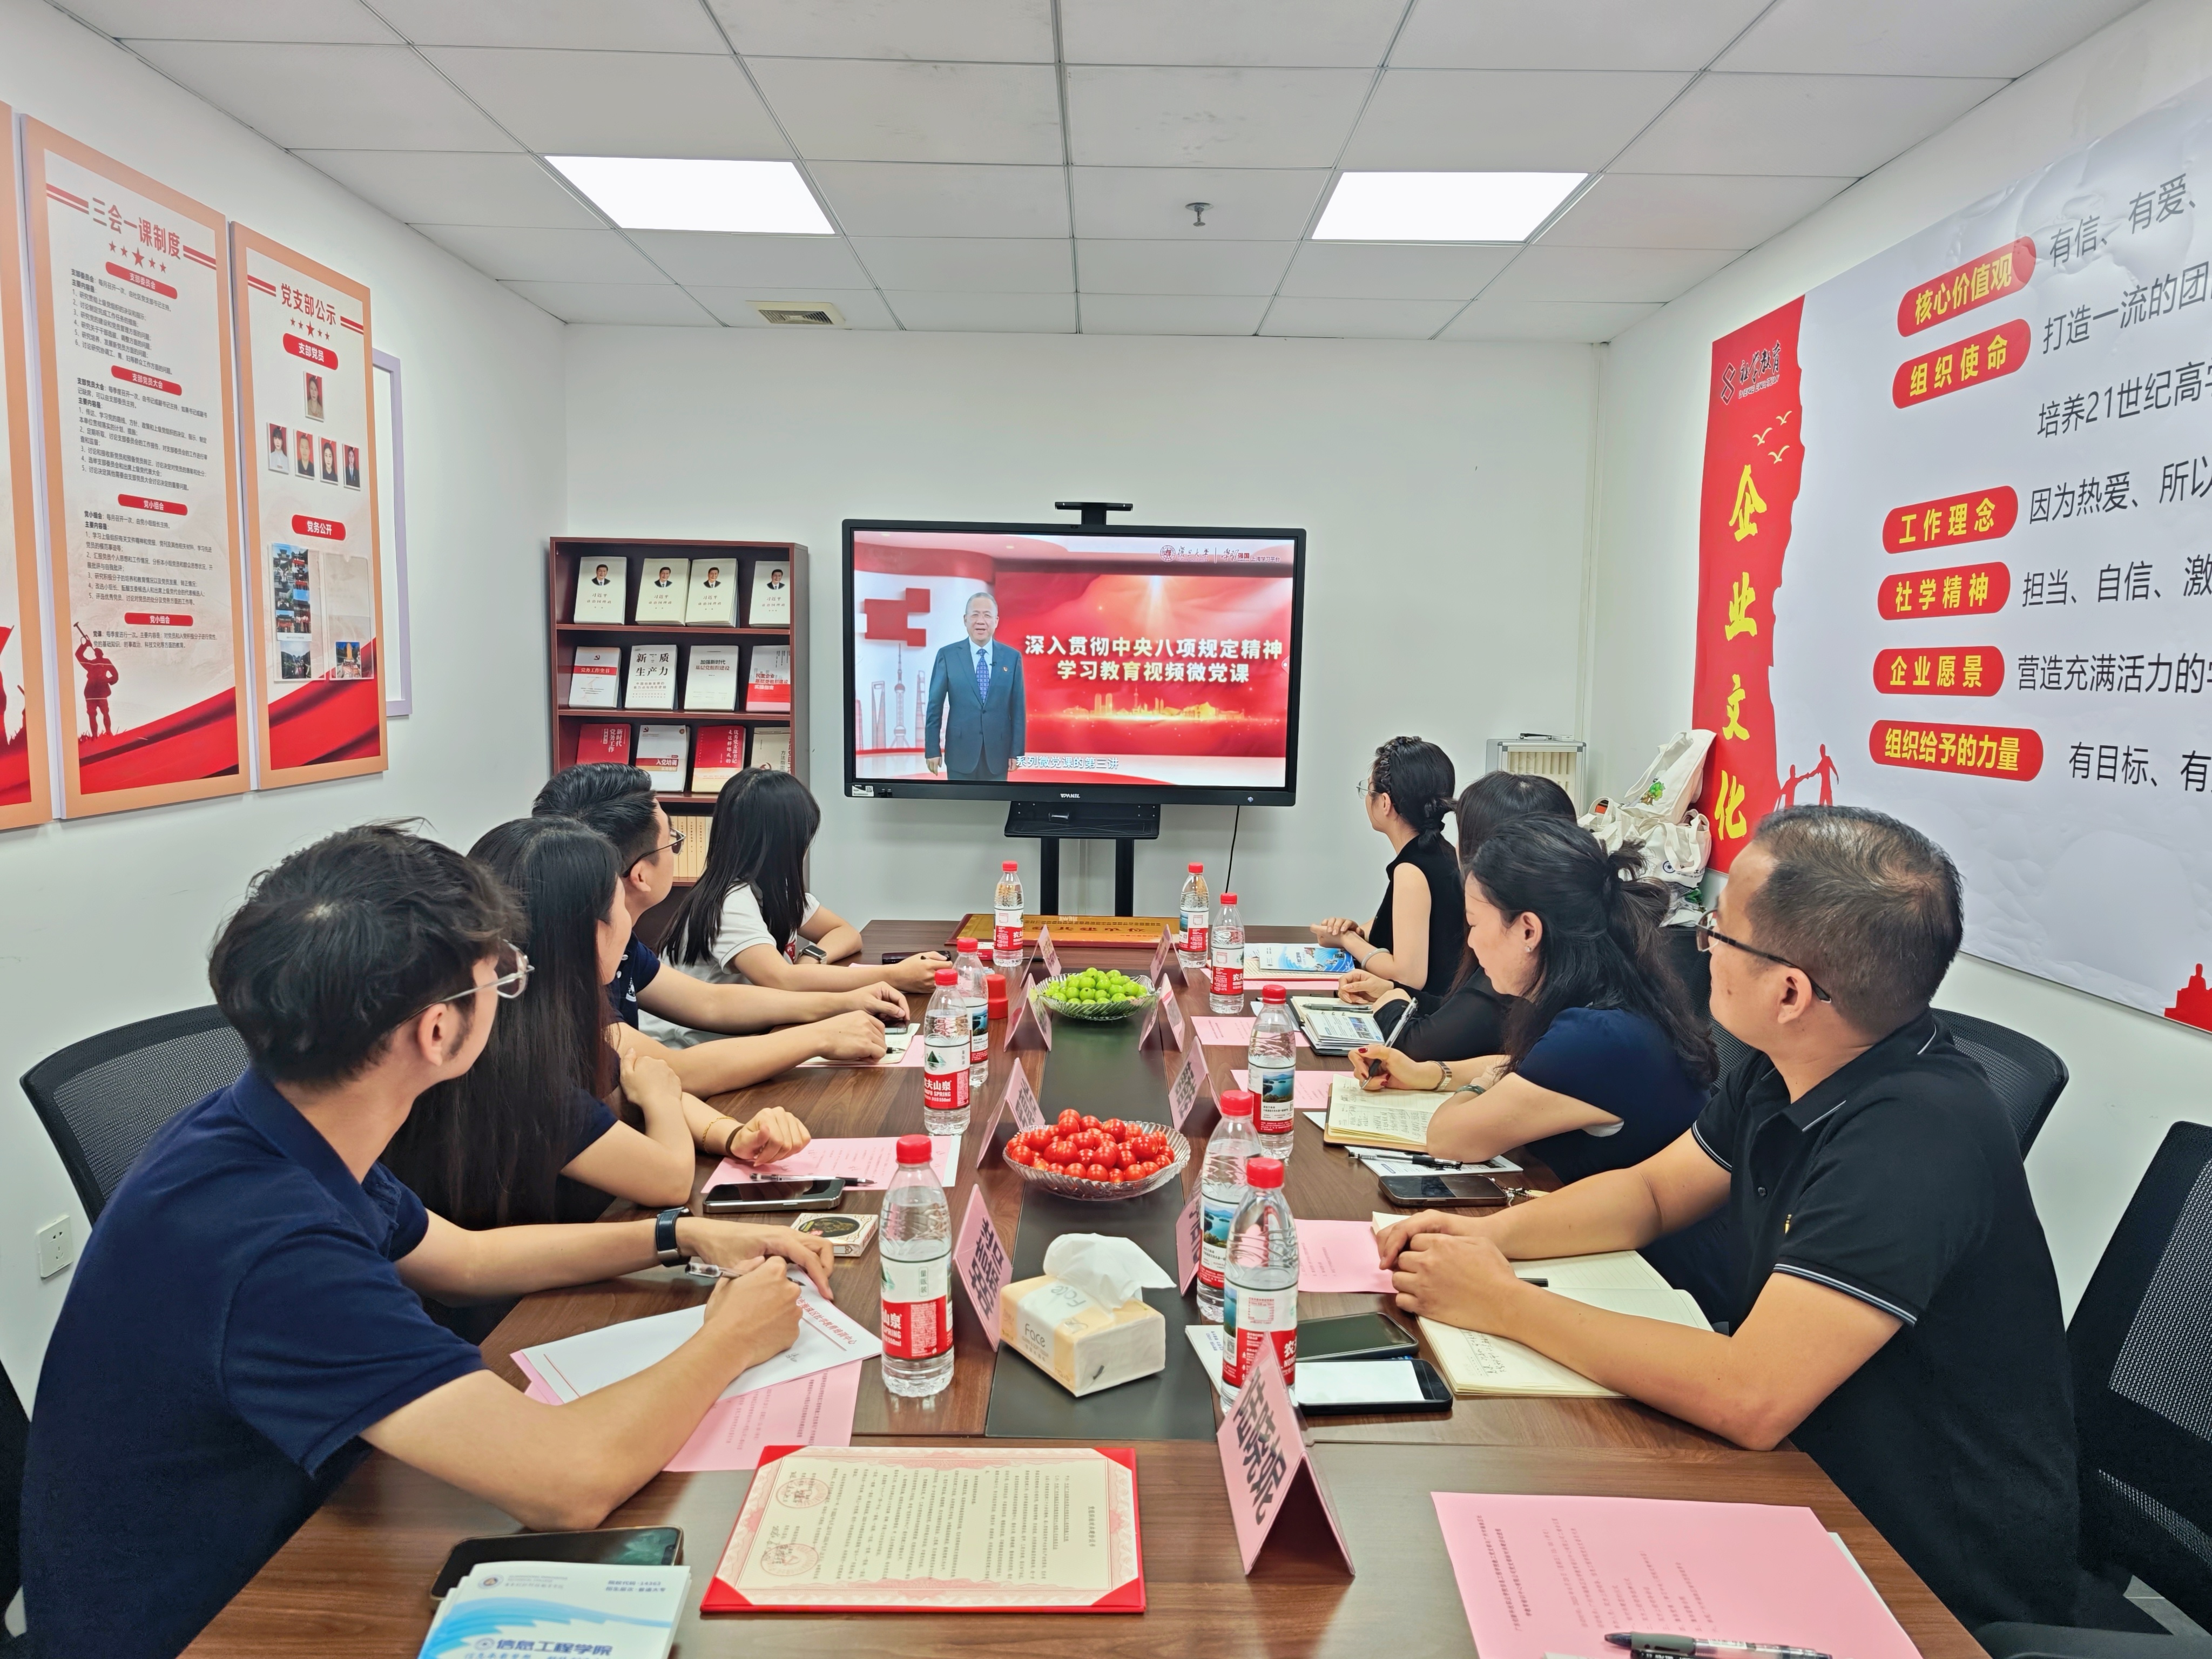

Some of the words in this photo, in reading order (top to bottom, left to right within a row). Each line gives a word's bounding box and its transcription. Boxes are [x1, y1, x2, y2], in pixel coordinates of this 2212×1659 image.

[92, 194, 180, 260] 三会一课制度
[129, 272, 156, 289] 支部委员会
[1916, 253, 2013, 325] 核心价值观
[281, 283, 336, 325] 党支部公示
[2044, 261, 2212, 354] 打造一流的团
[299, 342, 325, 362] 支部党员
[1910, 335, 2007, 397] 组织使命
[132, 374, 163, 389] 支部党员大会
[2038, 357, 2212, 439] 培养21世纪高
[144, 500, 164, 510] 党小组会
[1899, 498, 1995, 544] 工作理念
[307, 520, 332, 536] 党务公开
[1896, 572, 1988, 612] 社学精神
[150, 616, 170, 624] 党小组会
[1026, 635, 1283, 660] 深入贯彻中央八项规定精神
[1715, 464, 1767, 841] 企业文化
[636, 666, 668, 676] 生产力
[1057, 660, 1250, 683] 学习教育视频微党课
[1890, 655, 1982, 687] 企业愿景
[2018, 653, 2212, 693] 营造充满活力的
[608, 729, 616, 753] 党务工作
[1885, 728, 2020, 771] 组织给予的力量
[1016, 756, 1118, 770] 系列微党课的第三讲
[2069, 742, 2212, 792] 有目标、有
[968, 1217, 1004, 1320] 胡嘉浩
[1025, 1324, 1046, 1348] Face
[1233, 1366, 1287, 1526] 陆晓妮
[496, 1639, 613, 1656] 信息工程学院
